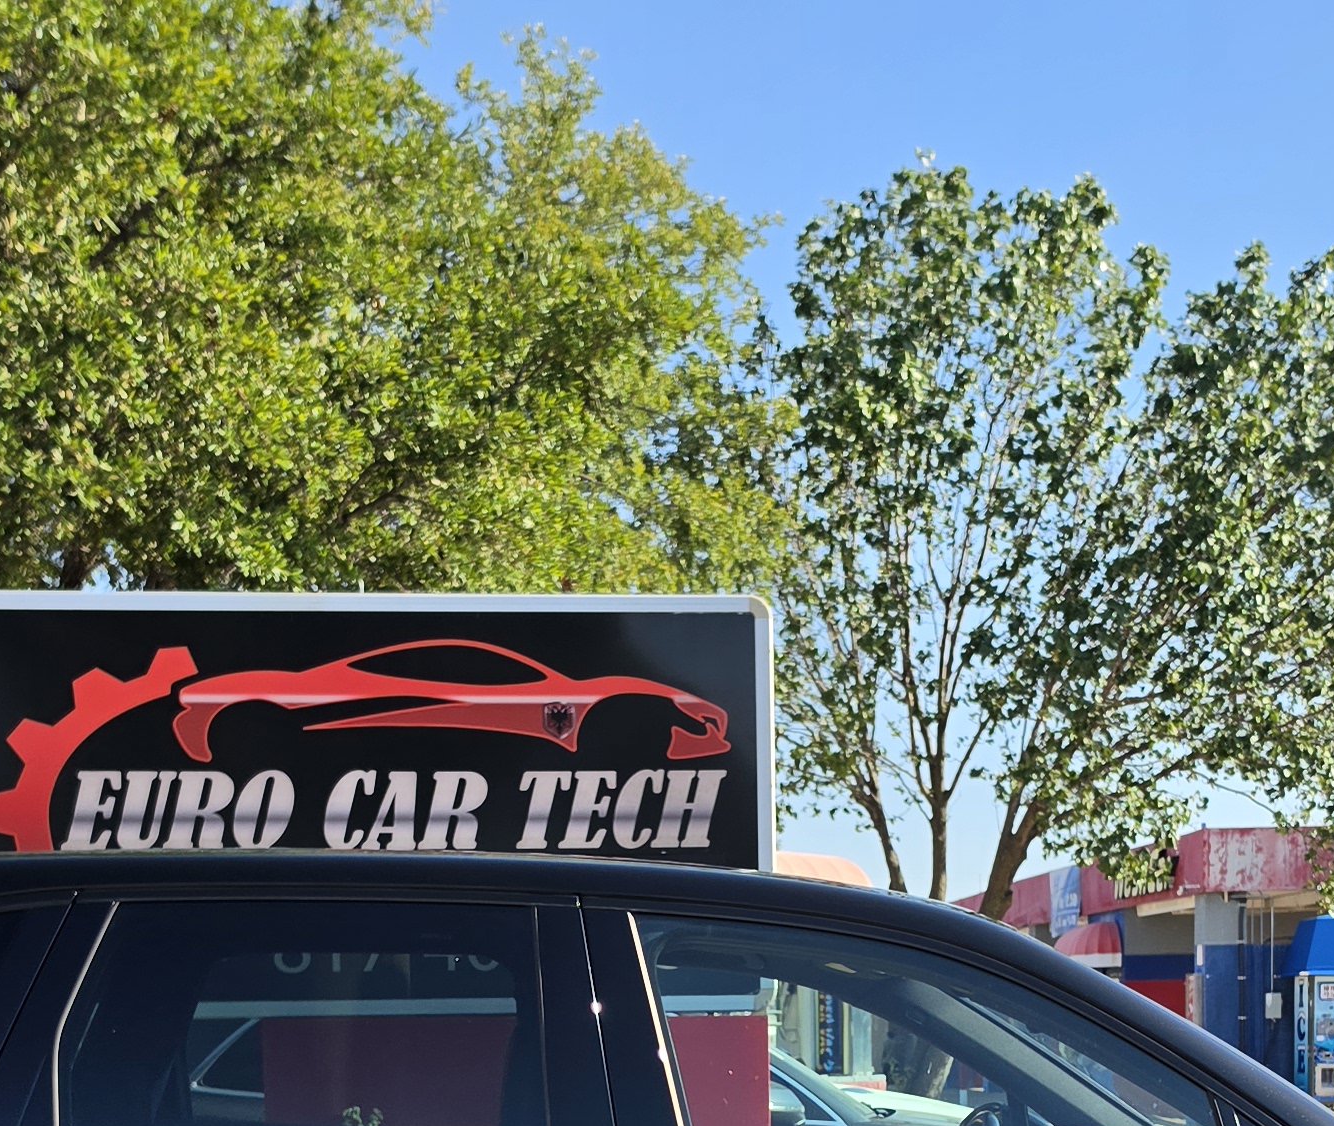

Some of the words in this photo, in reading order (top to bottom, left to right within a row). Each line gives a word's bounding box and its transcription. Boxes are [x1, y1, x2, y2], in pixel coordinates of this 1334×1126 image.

[61, 770, 295, 850] EURO
[323, 770, 488, 850] CAR
[516, 769, 728, 850] TECH
[1297, 980, 1306, 1074] ICE
